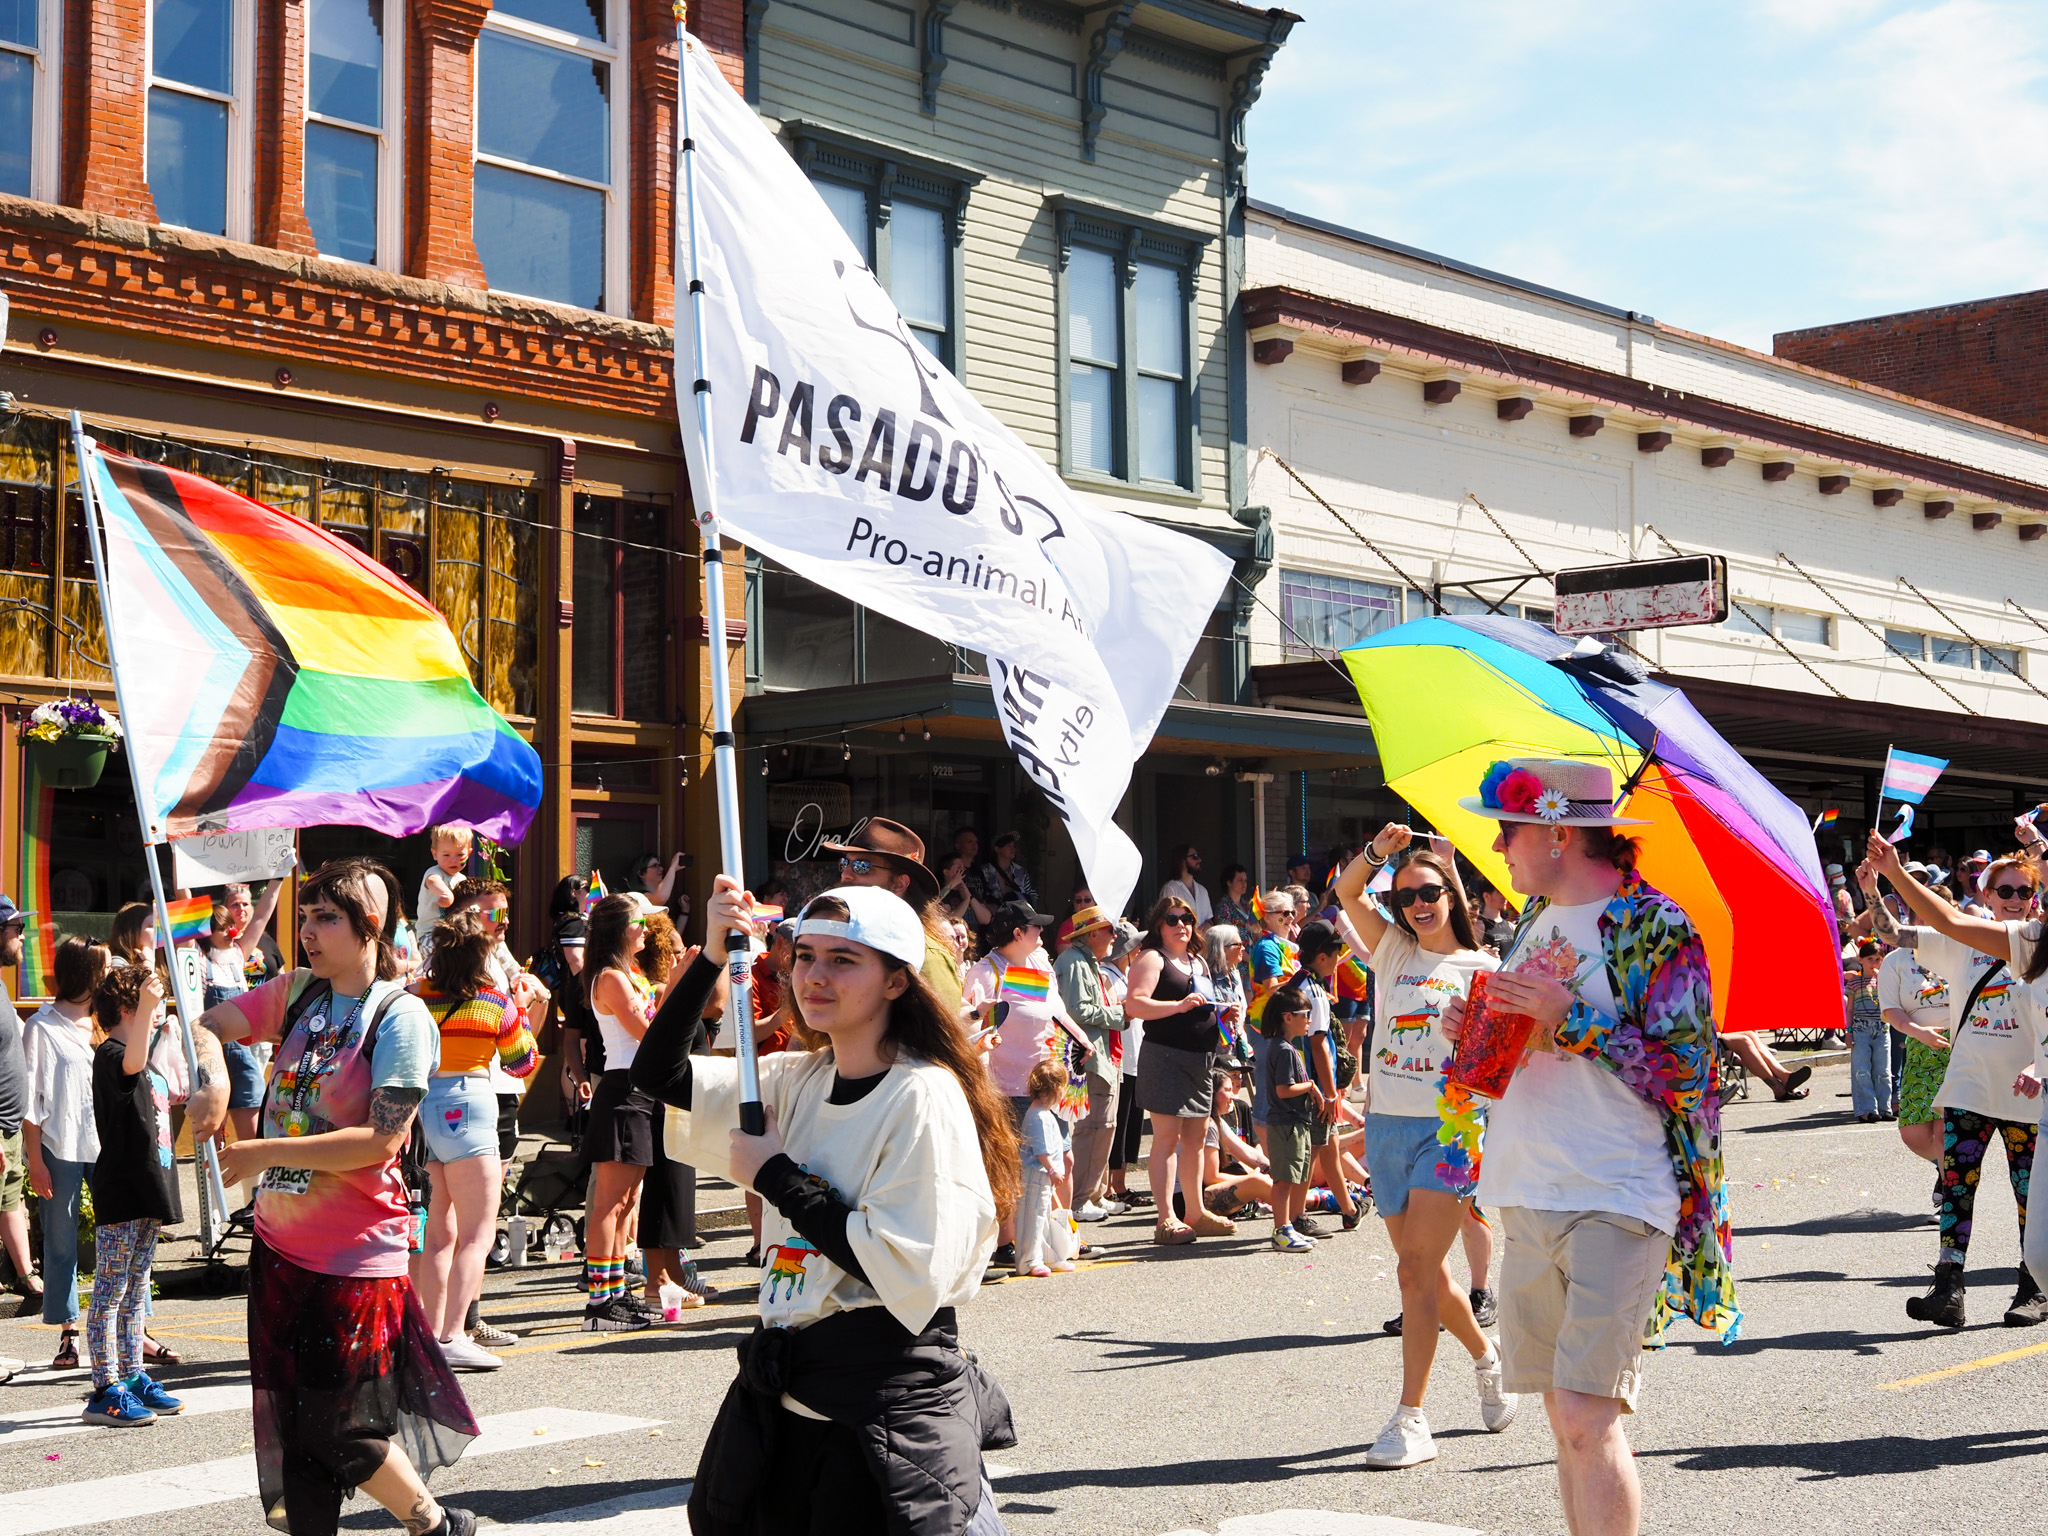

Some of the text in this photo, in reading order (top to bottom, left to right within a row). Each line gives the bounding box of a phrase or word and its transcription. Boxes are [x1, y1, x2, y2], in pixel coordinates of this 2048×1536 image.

[740, 364, 1024, 536] PASADO'S
[846, 516, 1053, 615] Pro-animal.
[1993, 1017, 2019, 1031] ALL
[1376, 1047, 1434, 1073] FOR ALL
